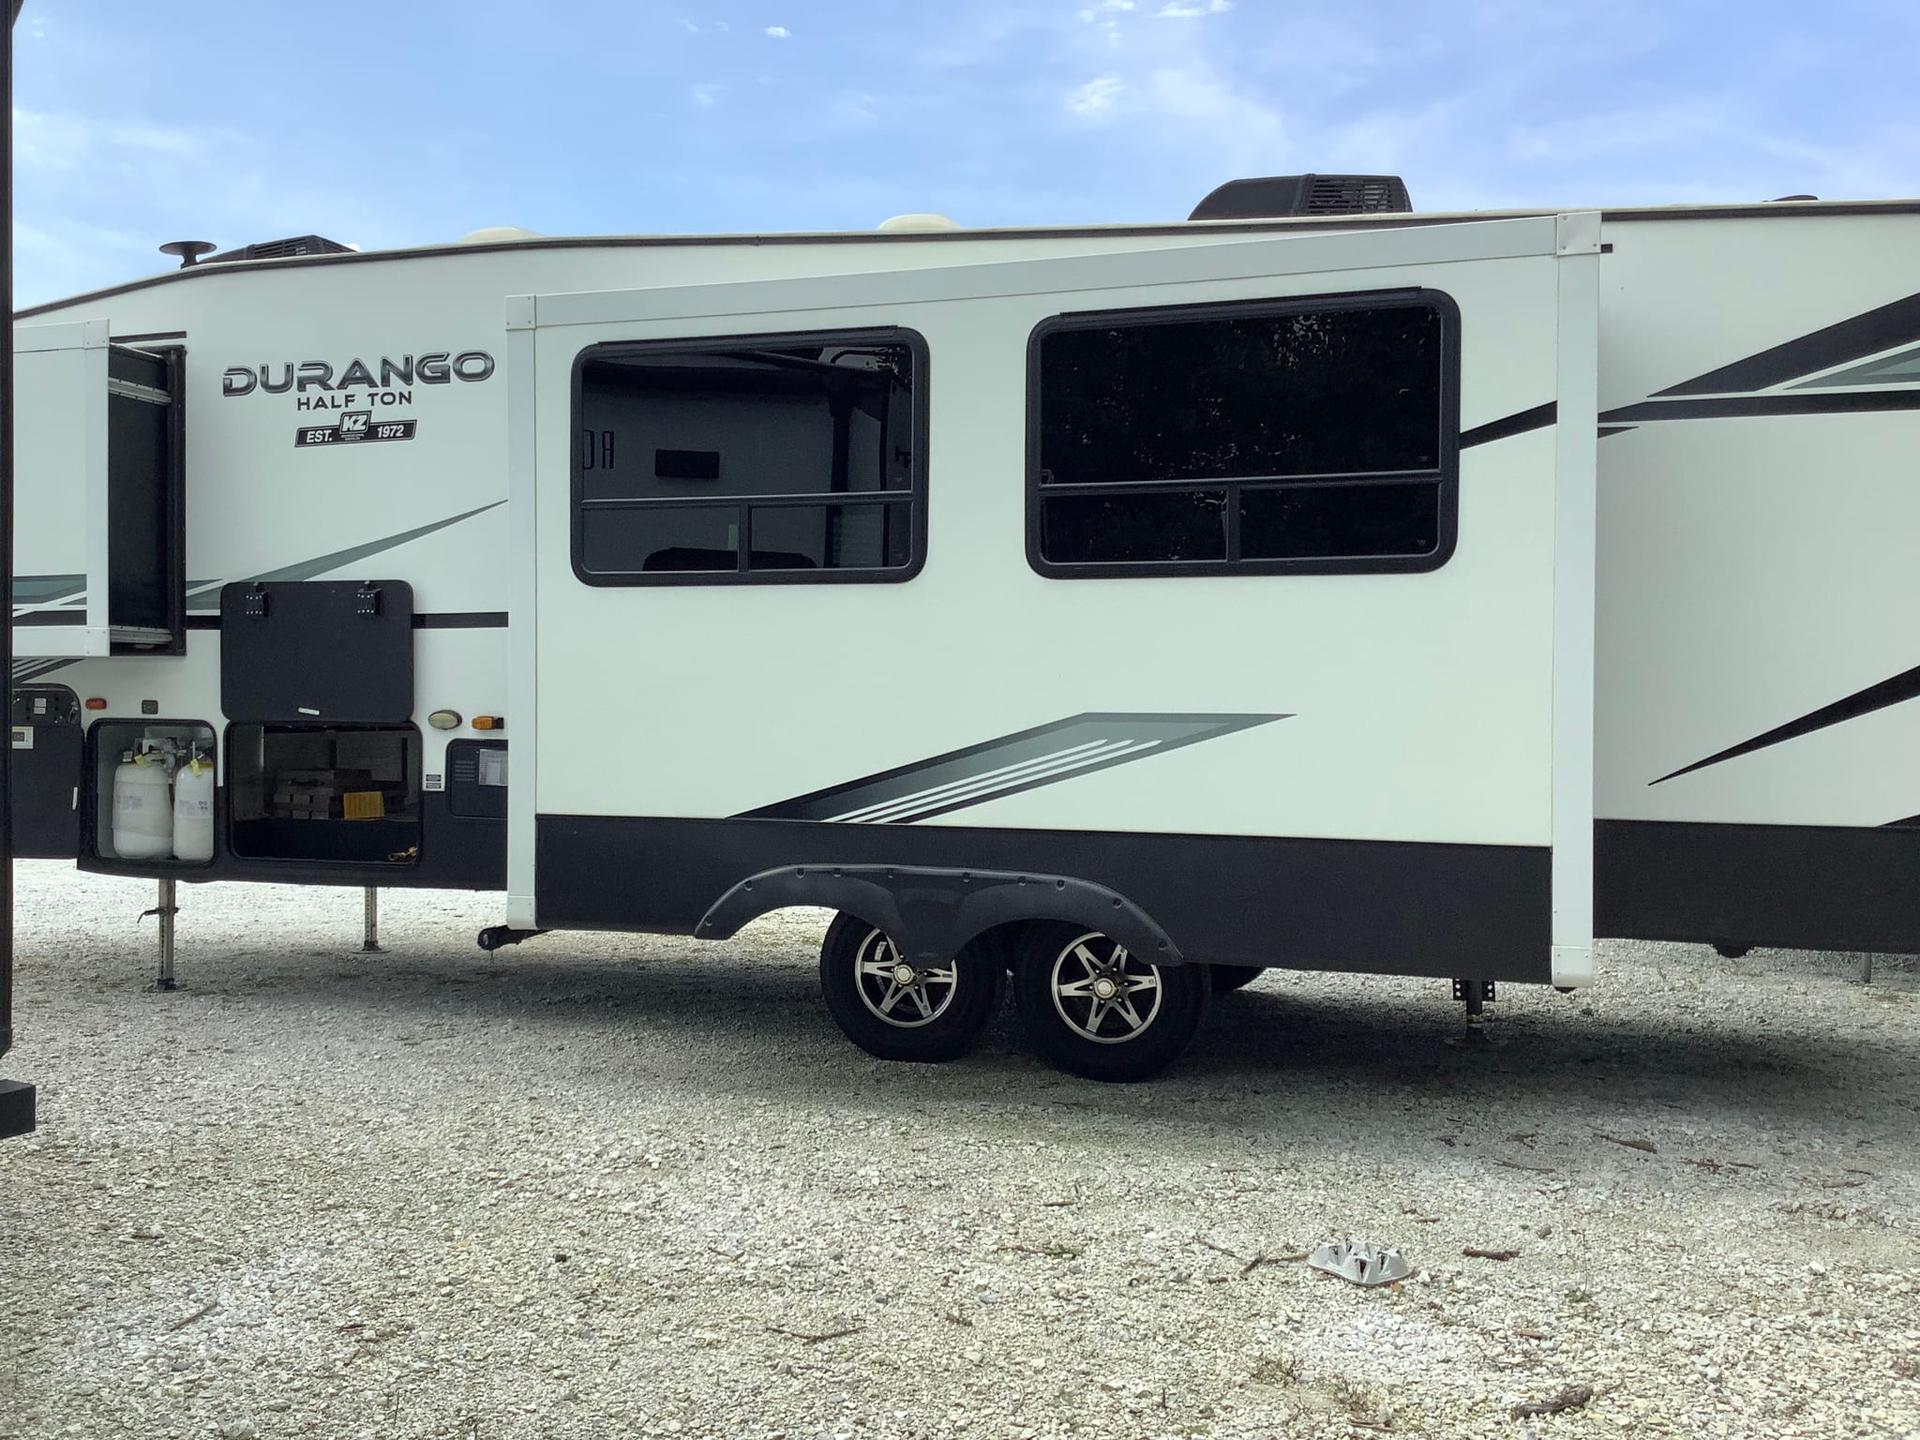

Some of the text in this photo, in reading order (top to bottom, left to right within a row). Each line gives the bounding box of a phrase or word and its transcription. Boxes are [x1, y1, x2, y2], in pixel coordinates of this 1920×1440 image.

[223, 350, 495, 397] DURANGO
[297, 391, 412, 411] HALF TON
[342, 415, 367, 431] KZ
[306, 429, 332, 443] EST.
[377, 425, 404, 438] 1972
